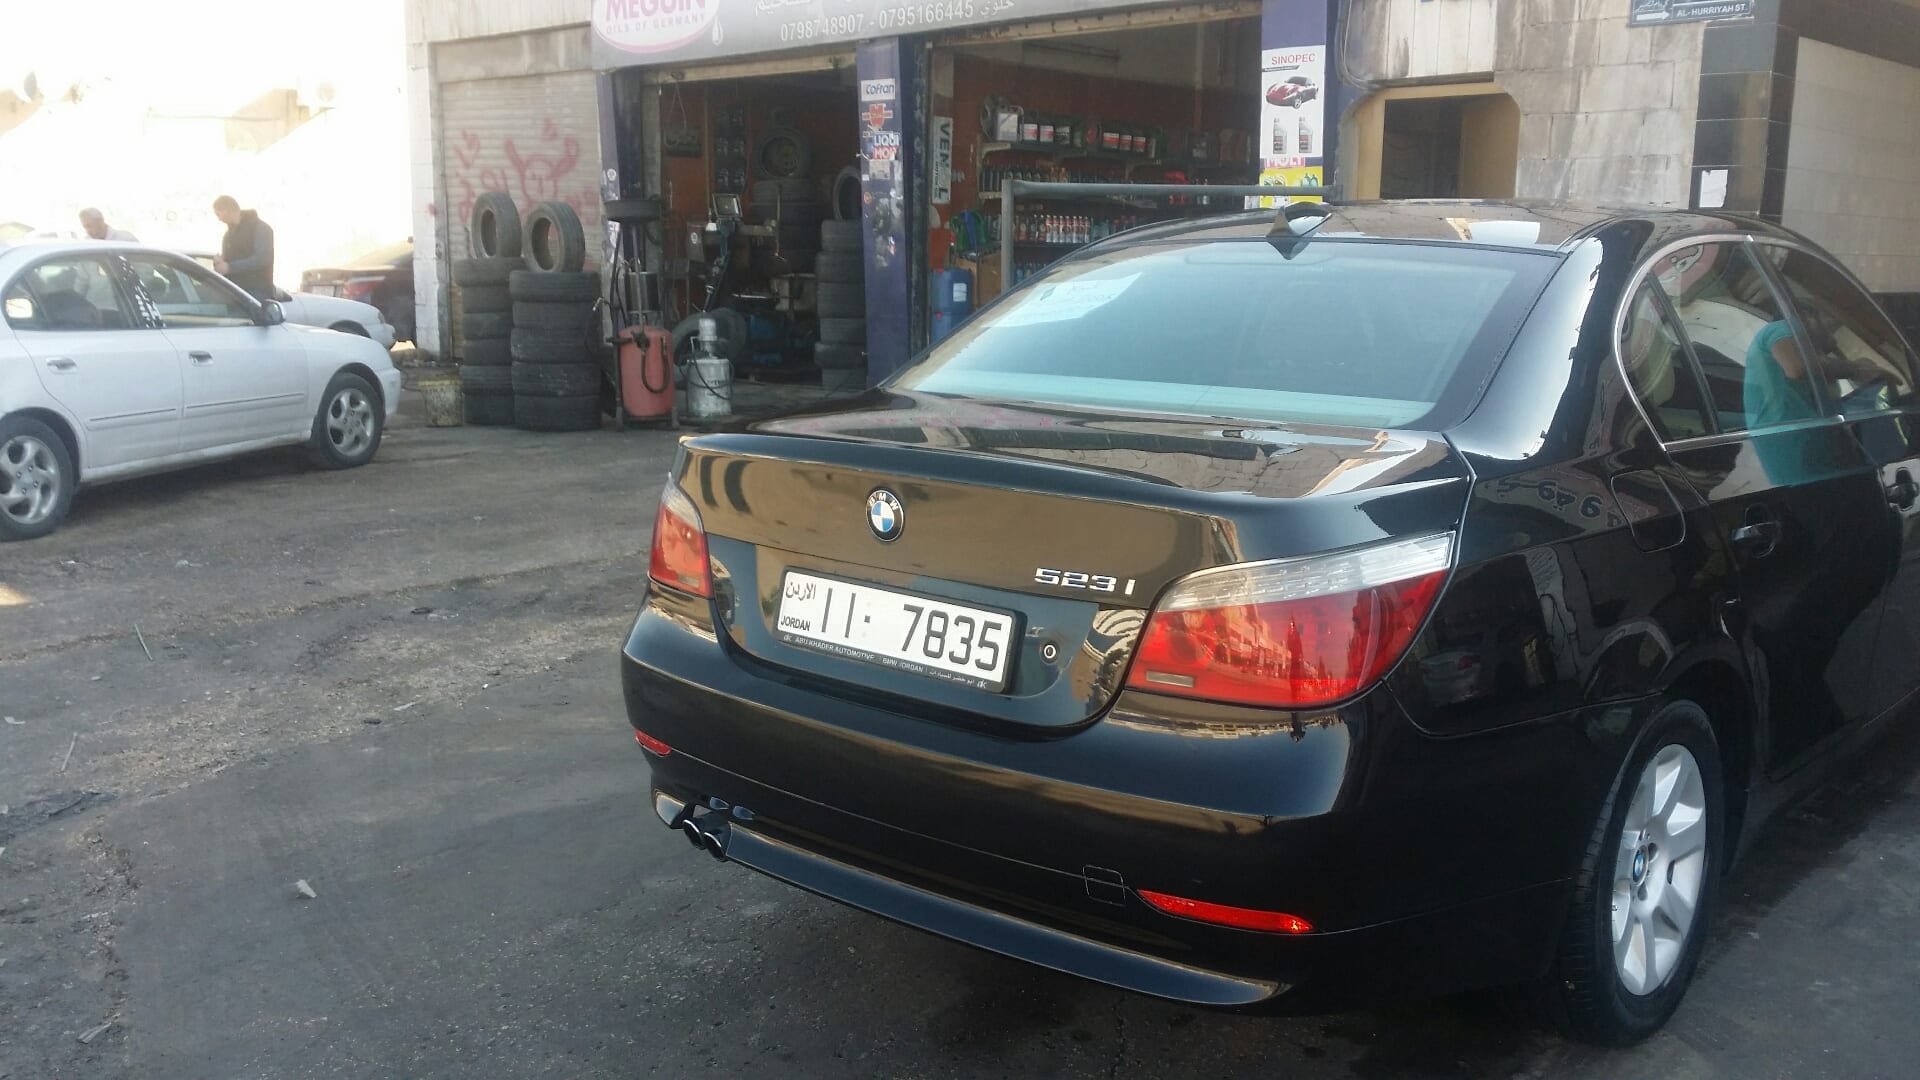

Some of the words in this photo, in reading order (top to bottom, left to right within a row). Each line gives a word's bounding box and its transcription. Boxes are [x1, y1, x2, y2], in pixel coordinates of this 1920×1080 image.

[606, 0, 705, 21] MEGUIN
[780, 13, 864, 42] 0798748907
[878, 2, 974, 30] 0795166445
[1271, 53, 1315, 65] SINOPEC
[873, 134, 899, 146] LIQUI
[868, 492, 899, 511] BMW
[780, 615, 811, 632] JORDAN
[901, 603, 1003, 672] 7835
